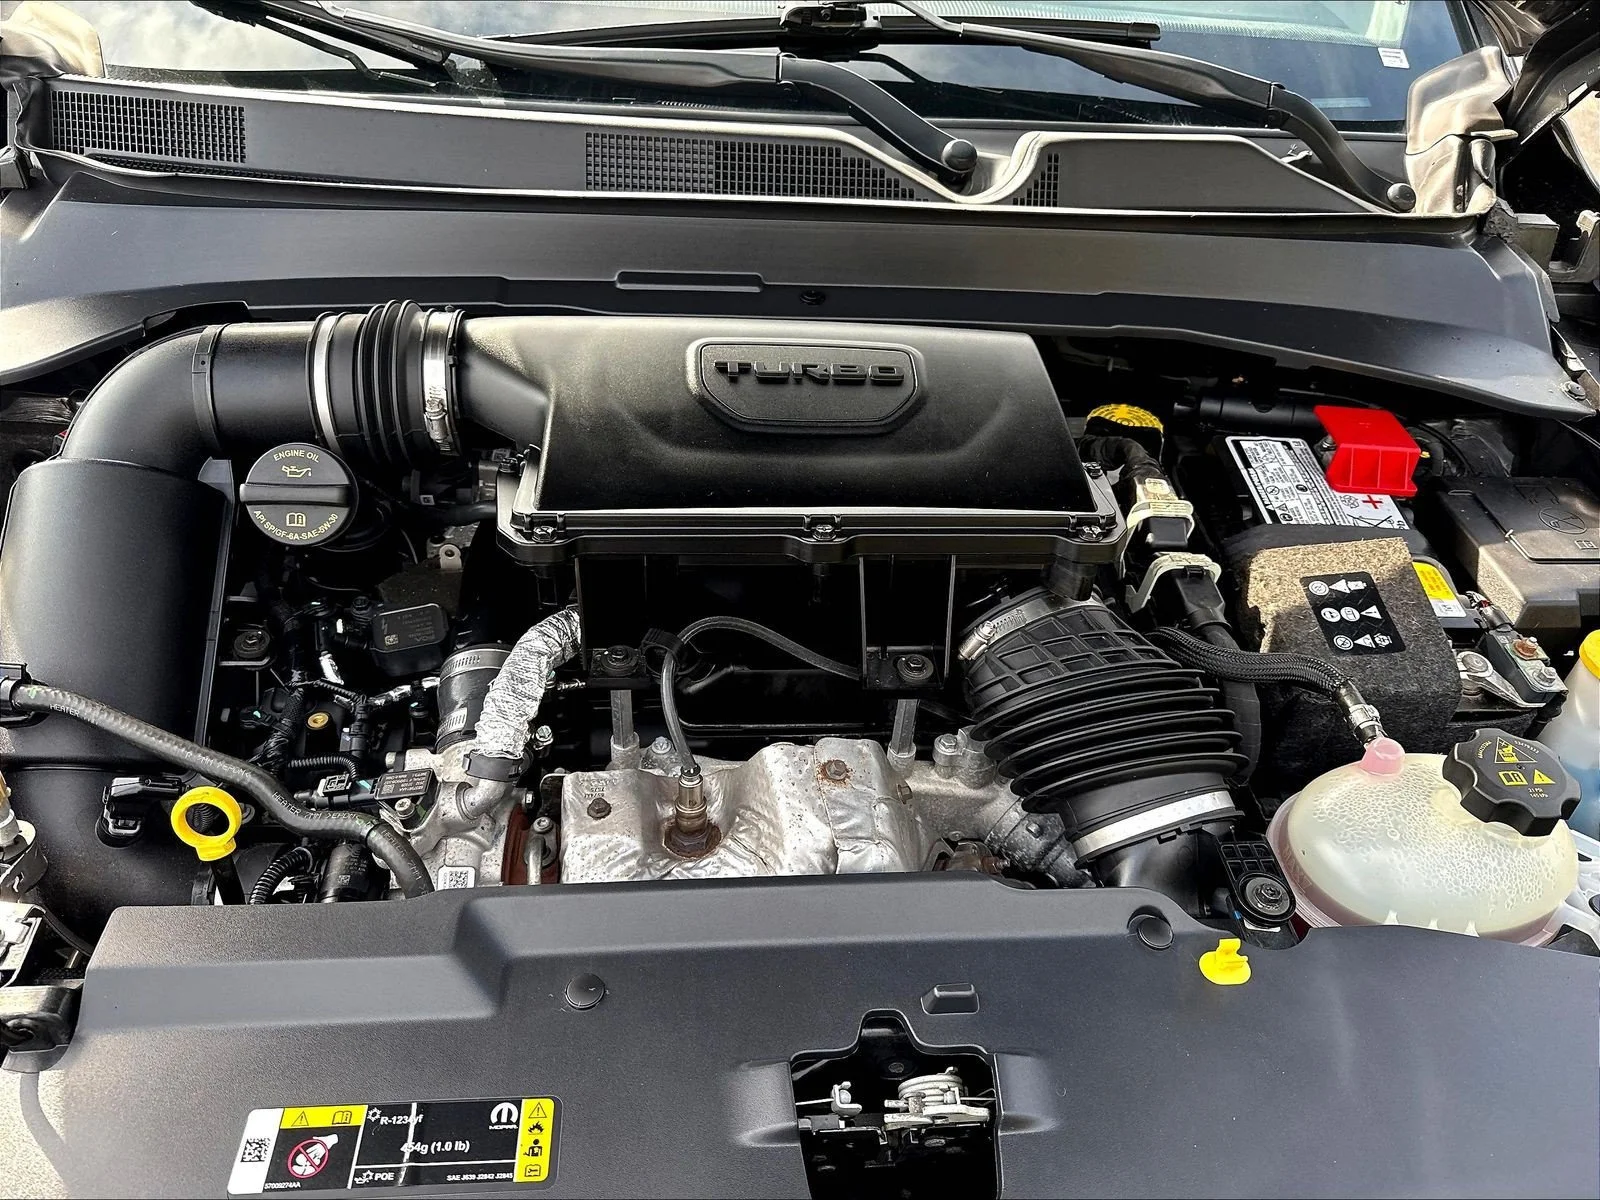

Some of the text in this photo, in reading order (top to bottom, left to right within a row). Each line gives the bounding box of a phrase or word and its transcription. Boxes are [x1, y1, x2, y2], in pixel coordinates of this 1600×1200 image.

[714, 361, 904, 382] TURBO
[273, 449, 321, 463] ENGINE OIL
[254, 510, 266, 524] API
[50, 703, 80, 717] HEATER
[272, 791, 302, 817] HEATER
[430, 1141, 453, 1155] (1.0
[454, 1140, 470, 1153] lb)
[374, 1172, 395, 1181] POE
